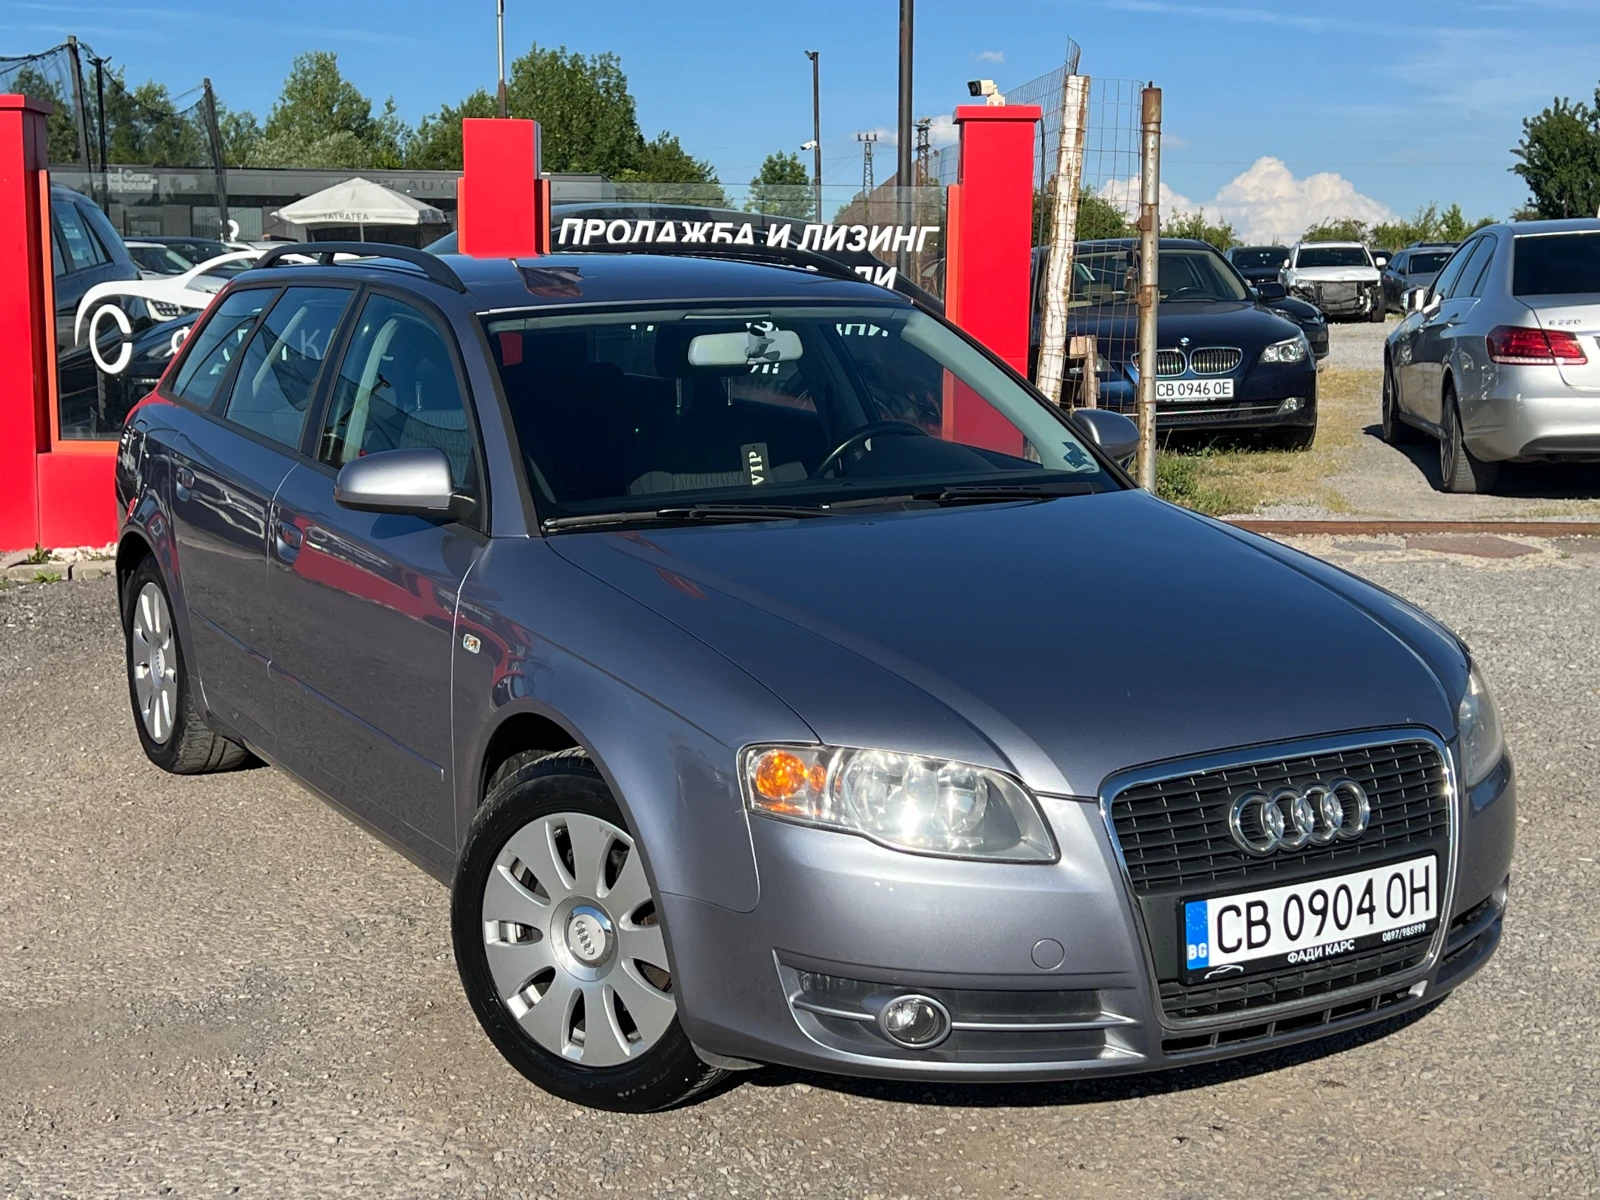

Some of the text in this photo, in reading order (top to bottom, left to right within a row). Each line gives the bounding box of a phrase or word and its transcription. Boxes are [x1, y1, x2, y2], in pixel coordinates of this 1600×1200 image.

[322, 212, 370, 221] TATRATEA
[766, 223, 792, 249] И
[796, 224, 940, 253] ЛИЗИНГ
[1156, 381, 1232, 397] CB 0946 OE
[748, 451, 765, 486] VIP
[1216, 864, 1430, 955] CB 0904 OH
[1187, 942, 1208, 961] BG
[1287, 939, 1356, 964] ФАДИ КАРС
